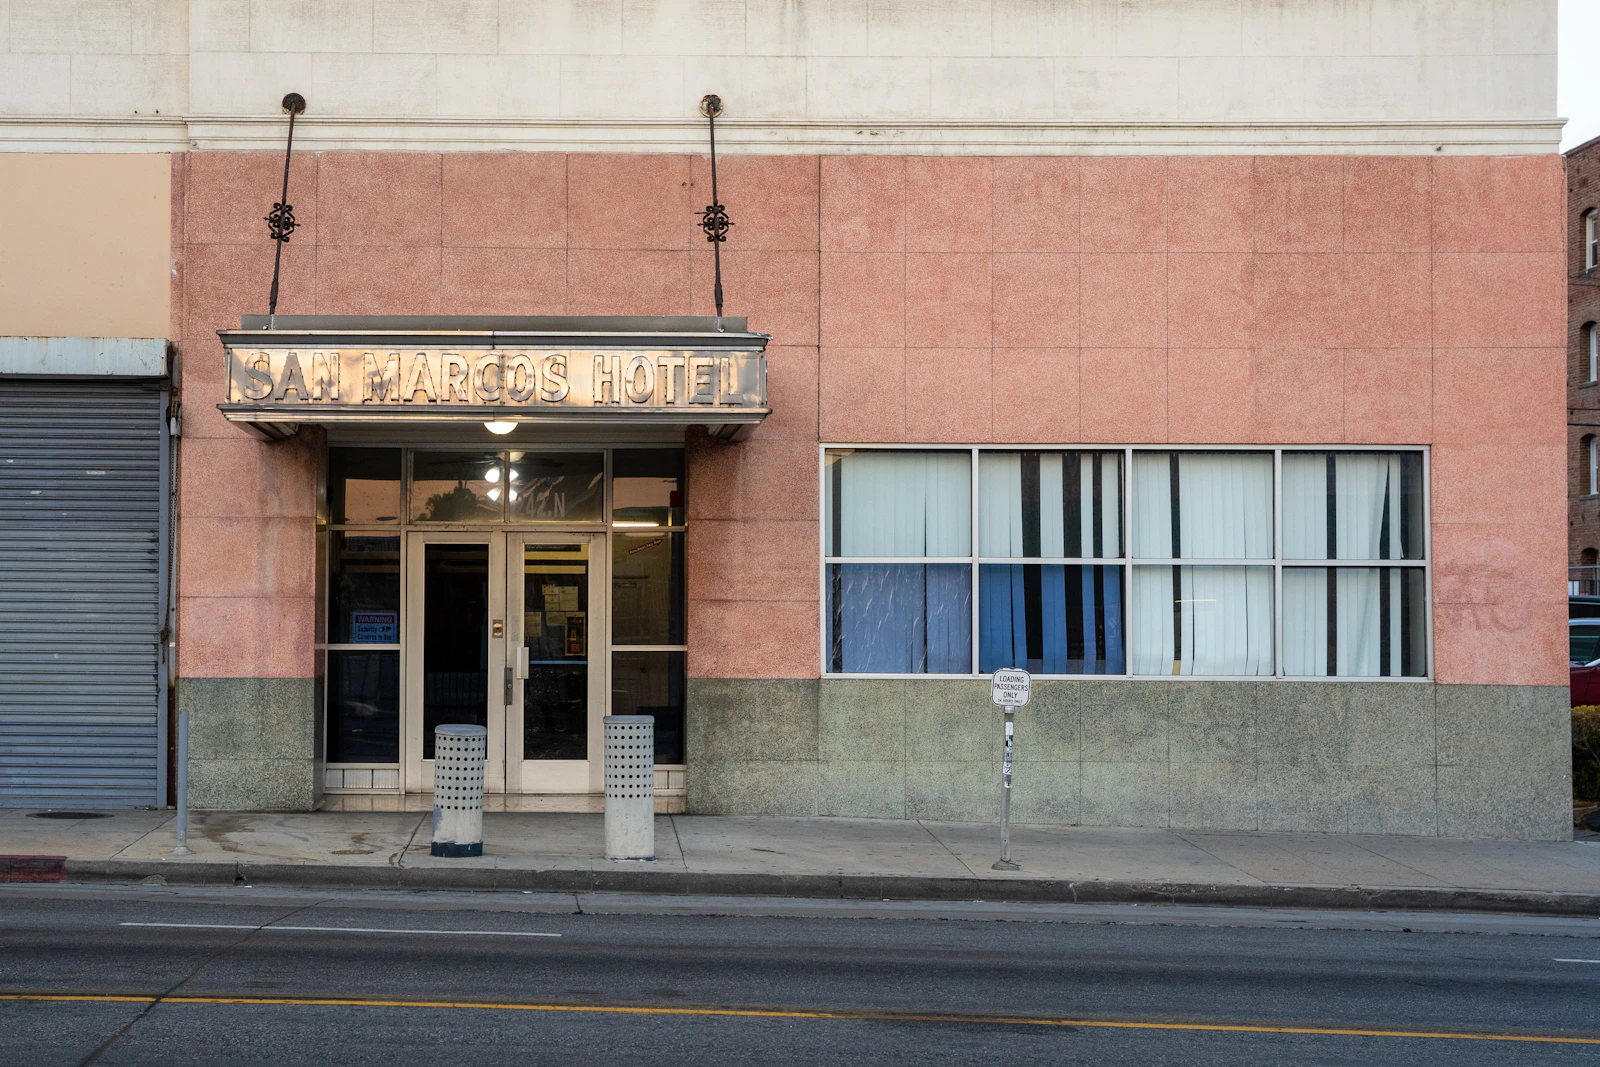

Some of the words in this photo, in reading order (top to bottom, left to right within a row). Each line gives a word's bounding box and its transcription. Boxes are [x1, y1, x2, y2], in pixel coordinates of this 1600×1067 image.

[244, 351, 340, 401] SAN
[362, 351, 570, 402] MARCOS
[593, 354, 744, 404] HOTEL
[357, 615, 393, 623] WARNING
[999, 675, 1025, 683] LOADING
[994, 683, 1029, 691] PASSENGERS
